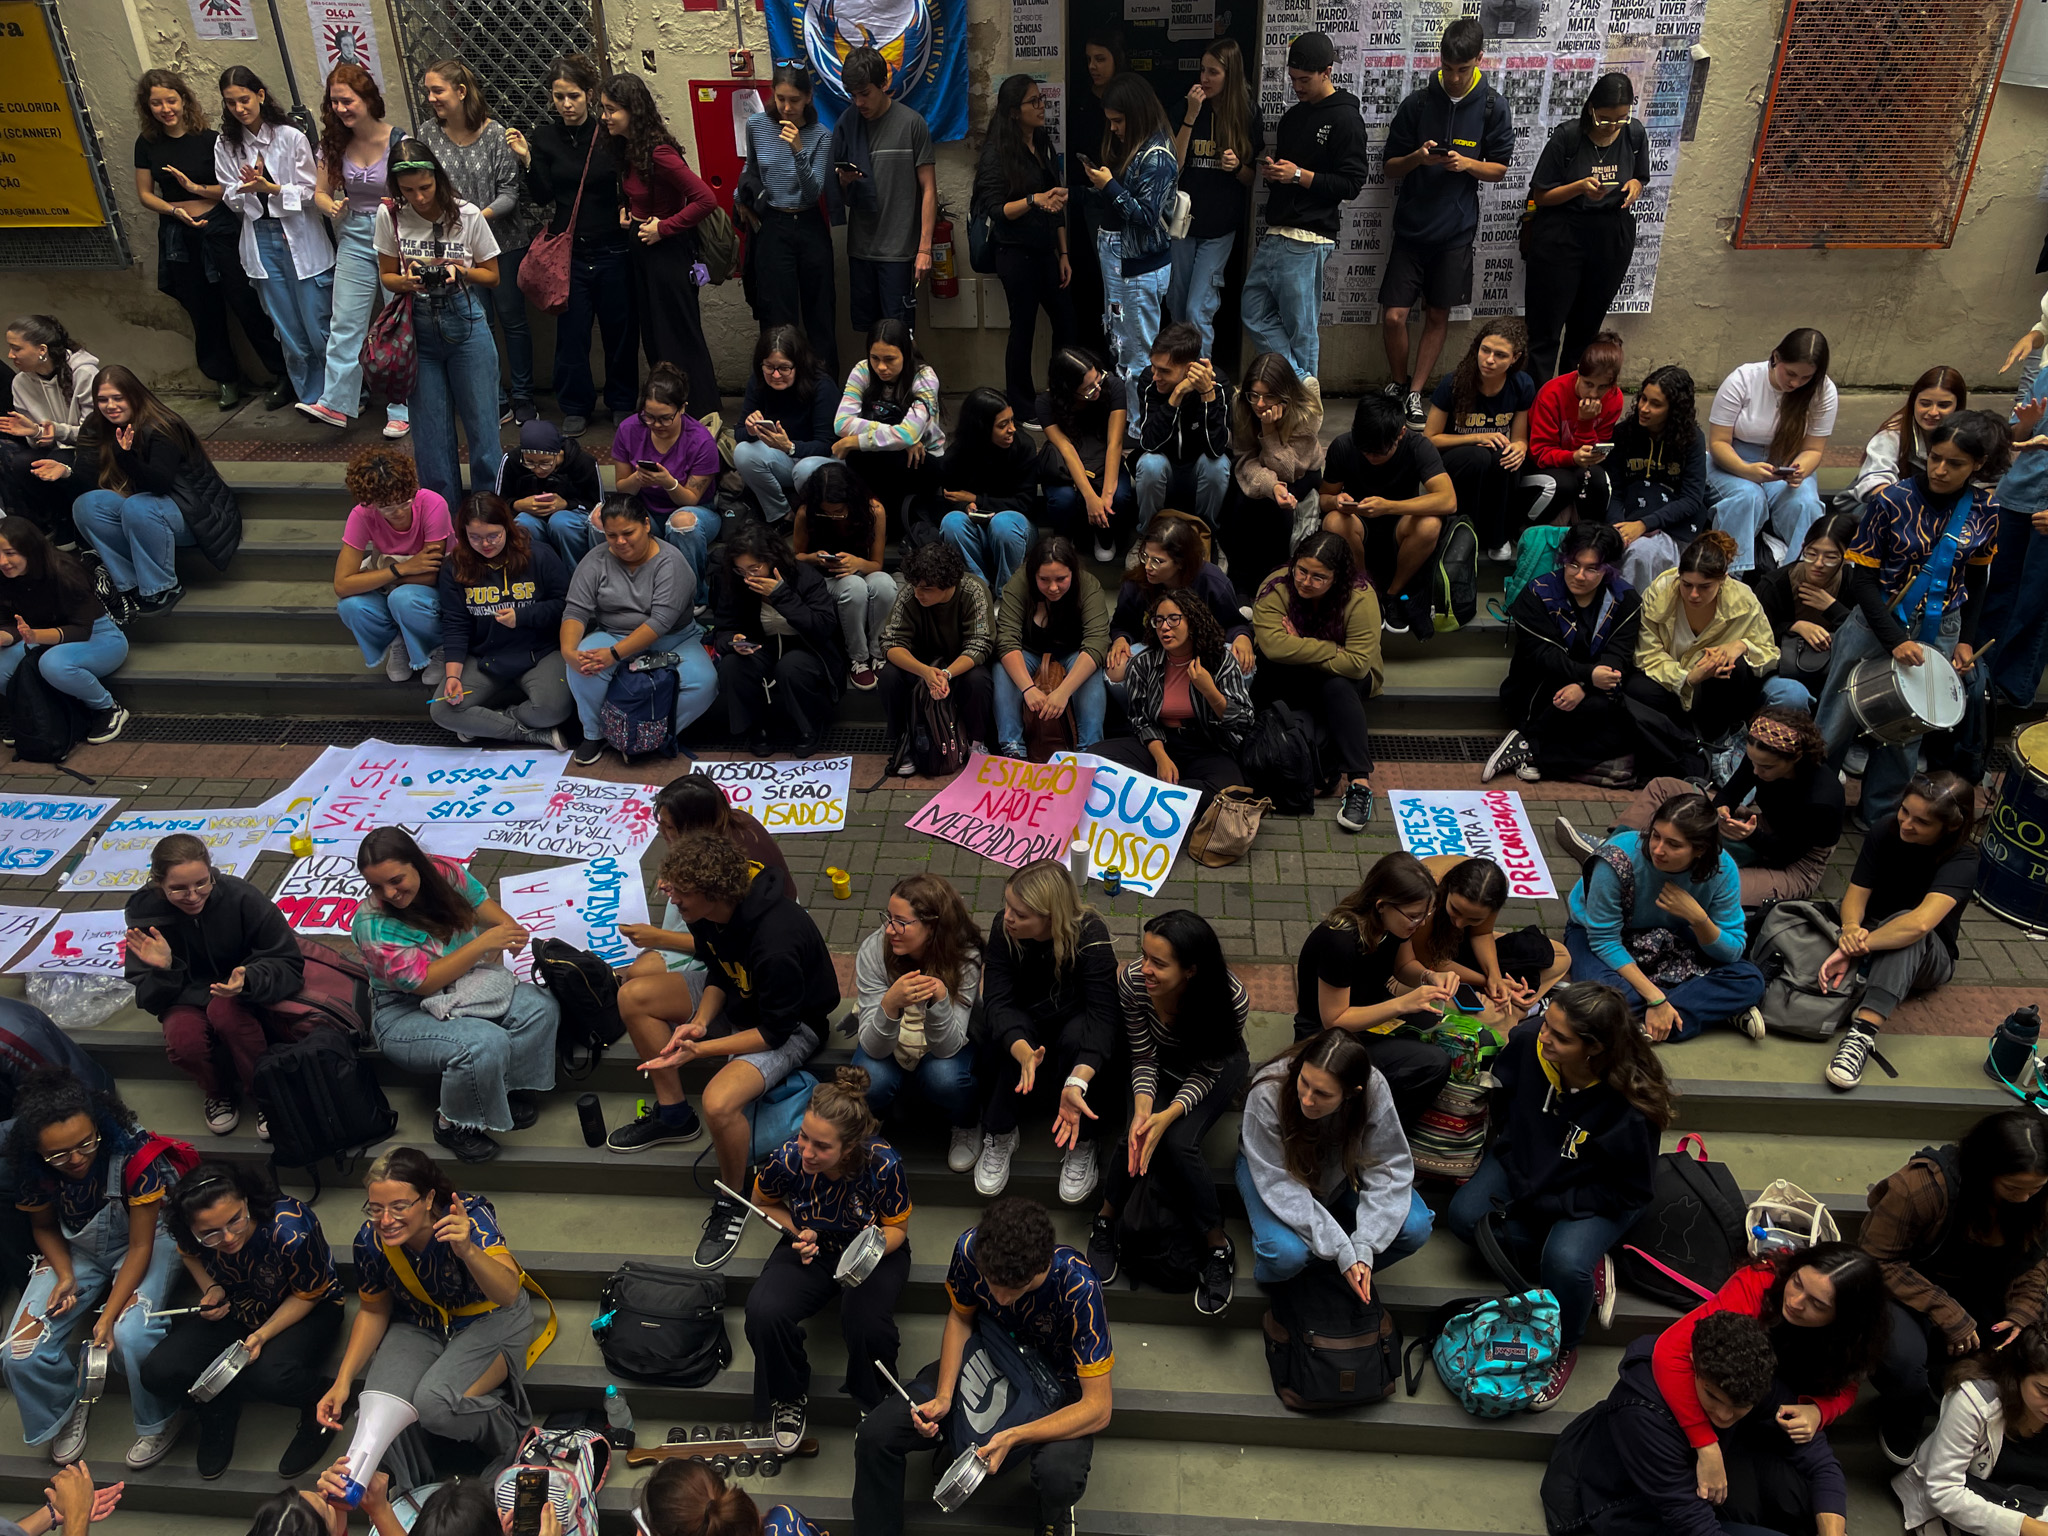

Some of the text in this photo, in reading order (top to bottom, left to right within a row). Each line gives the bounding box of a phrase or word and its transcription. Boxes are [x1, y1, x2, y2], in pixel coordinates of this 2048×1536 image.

[1171, 4, 1192, 13] SOCIO
[1284, 0, 1311, 11] BRASIL
[1380, 2, 1402, 10] FORÇA
[1660, 3, 1686, 15] VIVER
[1171, 14, 1213, 25] AMBIENTAIS
[1267, 14, 1299, 23] DA COROA
[1316, 8, 1347, 20] MARCO
[1372, 10, 1402, 20] DA TERRA
[1610, 8, 1655, 20] TEMPORAL
[1013, 22, 1042, 33] CIÊNCIAS
[1315, 22, 1359, 33] TEMPORAL
[1376, 21, 1396, 30] VIVE
[1425, 20, 1443, 31] 70%
[1567, 18, 1595, 31] MATA
[1655, 23, 1701, 34] BEM VIVER
[1014, 35, 1036, 46] SOCIO
[1265, 34, 1278, 45] DO
[1370, 33, 1384, 45] EM
[1384, 30, 1401, 44] NÓS
[1015, 46, 1058, 57] AMBIENTAIS
[1557, 41, 1600, 51] AMBIENTAIS
[1656, 50, 1688, 62] A FOME
[1656, 81, 1675, 93] 70%
[7, 102, 61, 113] COLORIDA
[3, 127, 62, 139] (SCANNER)
[1650, 158, 1668, 172] NÓS
[1630, 201, 1654, 212] ARCO
[1484, 213, 1515, 222] DA COROA
[1353, 220, 1382, 228] DA TERRA
[1357, 228, 1376, 236] VIVE
[1482, 232, 1493, 242] DO
[1351, 237, 1380, 250] EM NÓS
[1485, 259, 1514, 270] BRASIL
[1347, 266, 1376, 276] A FOME
[1494, 271, 1513, 282] PAÍS
[1350, 292, 1367, 302] 70%
[1483, 289, 1508, 300] MATA
[1473, 307, 1513, 316] AMBIENTAIS
[1626, 301, 1649, 311] VIVER
[427, 760, 537, 784] NOSSO
[693, 759, 849, 785] NOSSOS ESTÁGIOS
[762, 780, 832, 800] SERÃO
[973, 786, 1031, 823] NÃO
[1084, 766, 1188, 839] SUS
[427, 800, 516, 819] O SUS
[563, 815, 598, 825] DOS
[1399, 797, 1438, 856] DEFESA
[20, 828, 67, 842] NÃO
[574, 825, 612, 840] TIRA
[483, 829, 627, 858] RICARDO NUNES
[1480, 790, 1549, 896] PRECARIZAÇÃO
